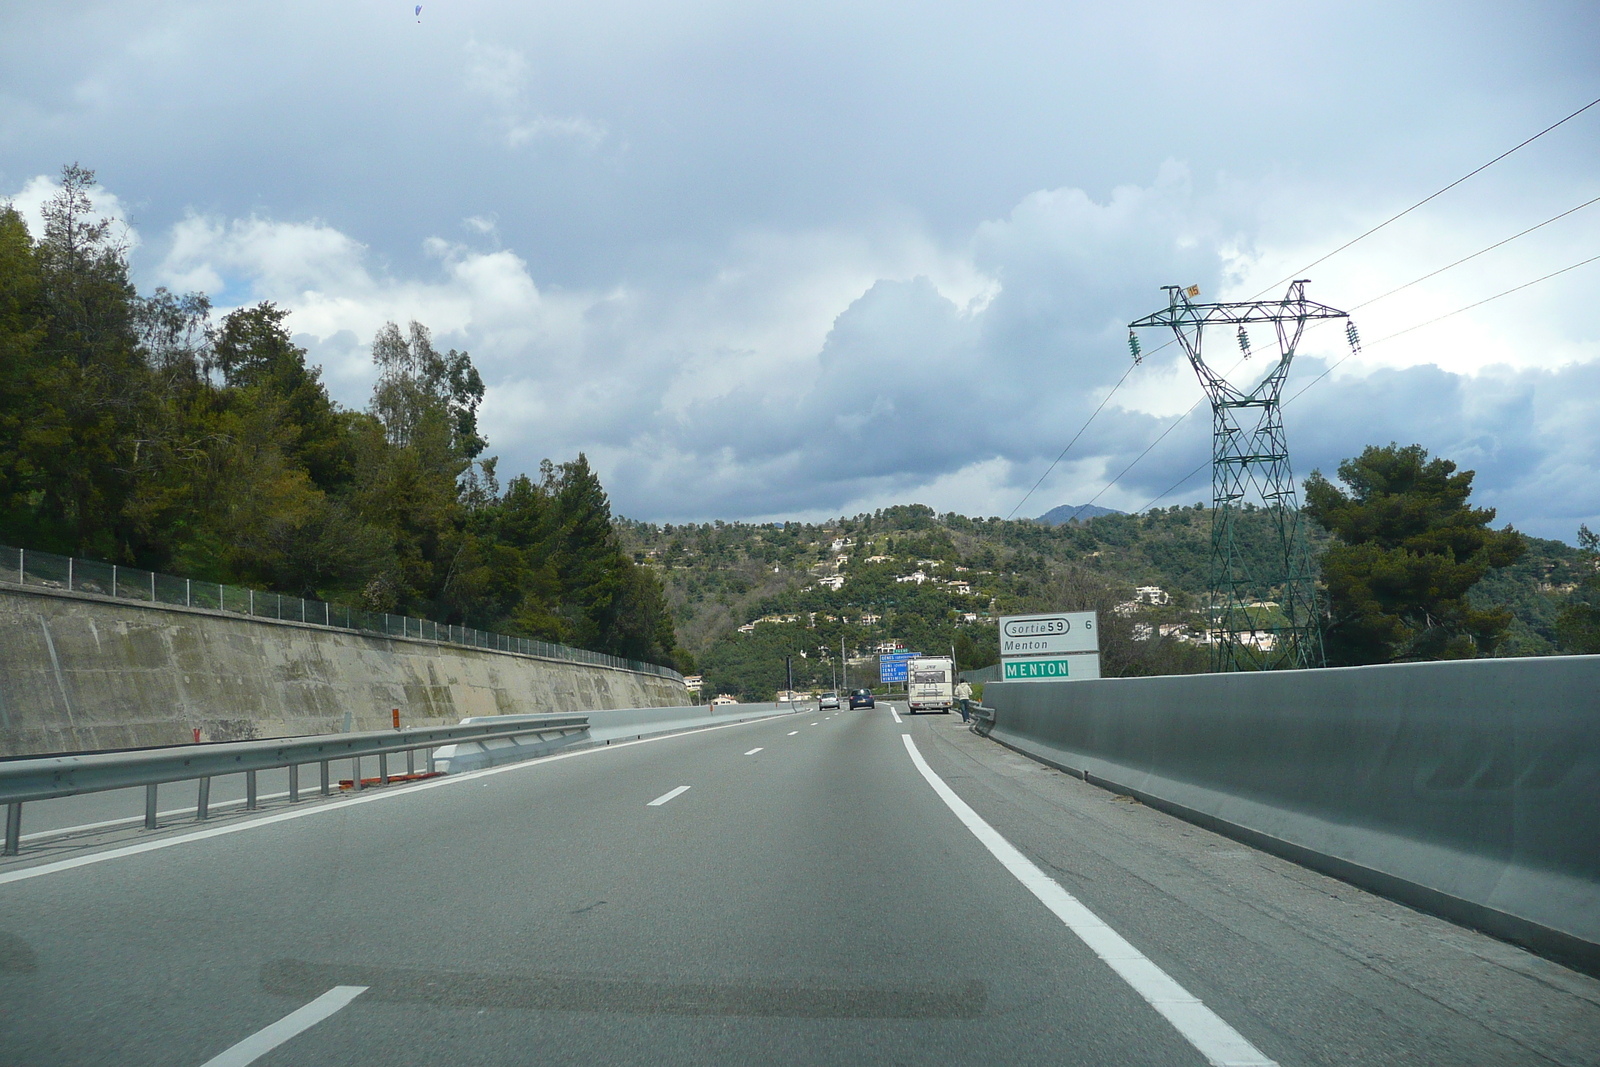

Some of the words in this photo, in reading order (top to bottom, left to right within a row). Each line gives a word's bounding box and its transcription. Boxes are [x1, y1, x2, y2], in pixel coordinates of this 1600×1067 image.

[1012, 623, 1046, 633] sortie
[1047, 622, 1063, 631] 59
[1085, 620, 1092, 629] 6
[1004, 641, 1048, 650] Menton
[1007, 662, 1066, 676] MENTON
